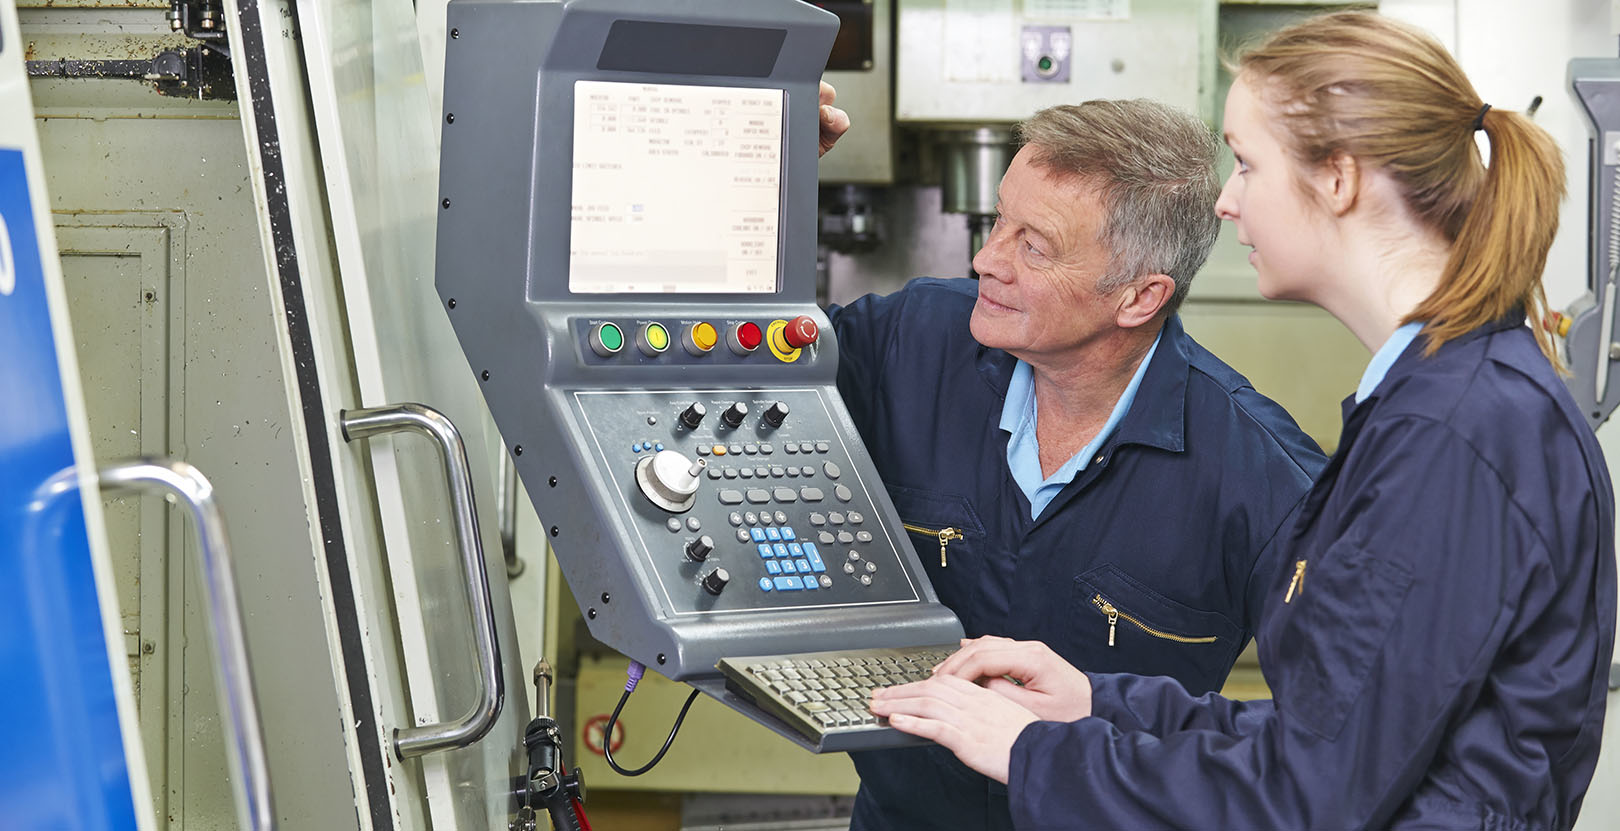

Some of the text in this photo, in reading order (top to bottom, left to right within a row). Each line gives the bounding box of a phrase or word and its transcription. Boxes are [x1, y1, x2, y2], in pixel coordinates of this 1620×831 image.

[755, 530, 762, 538] 7
[770, 529, 778, 537] 8
[785, 529, 792, 537] 9
[763, 546, 770, 554] 4
[794, 545, 800, 553] 6
[786, 562, 793, 570] 2
[801, 561, 808, 569] 3
[786, 578, 793, 586] 0
